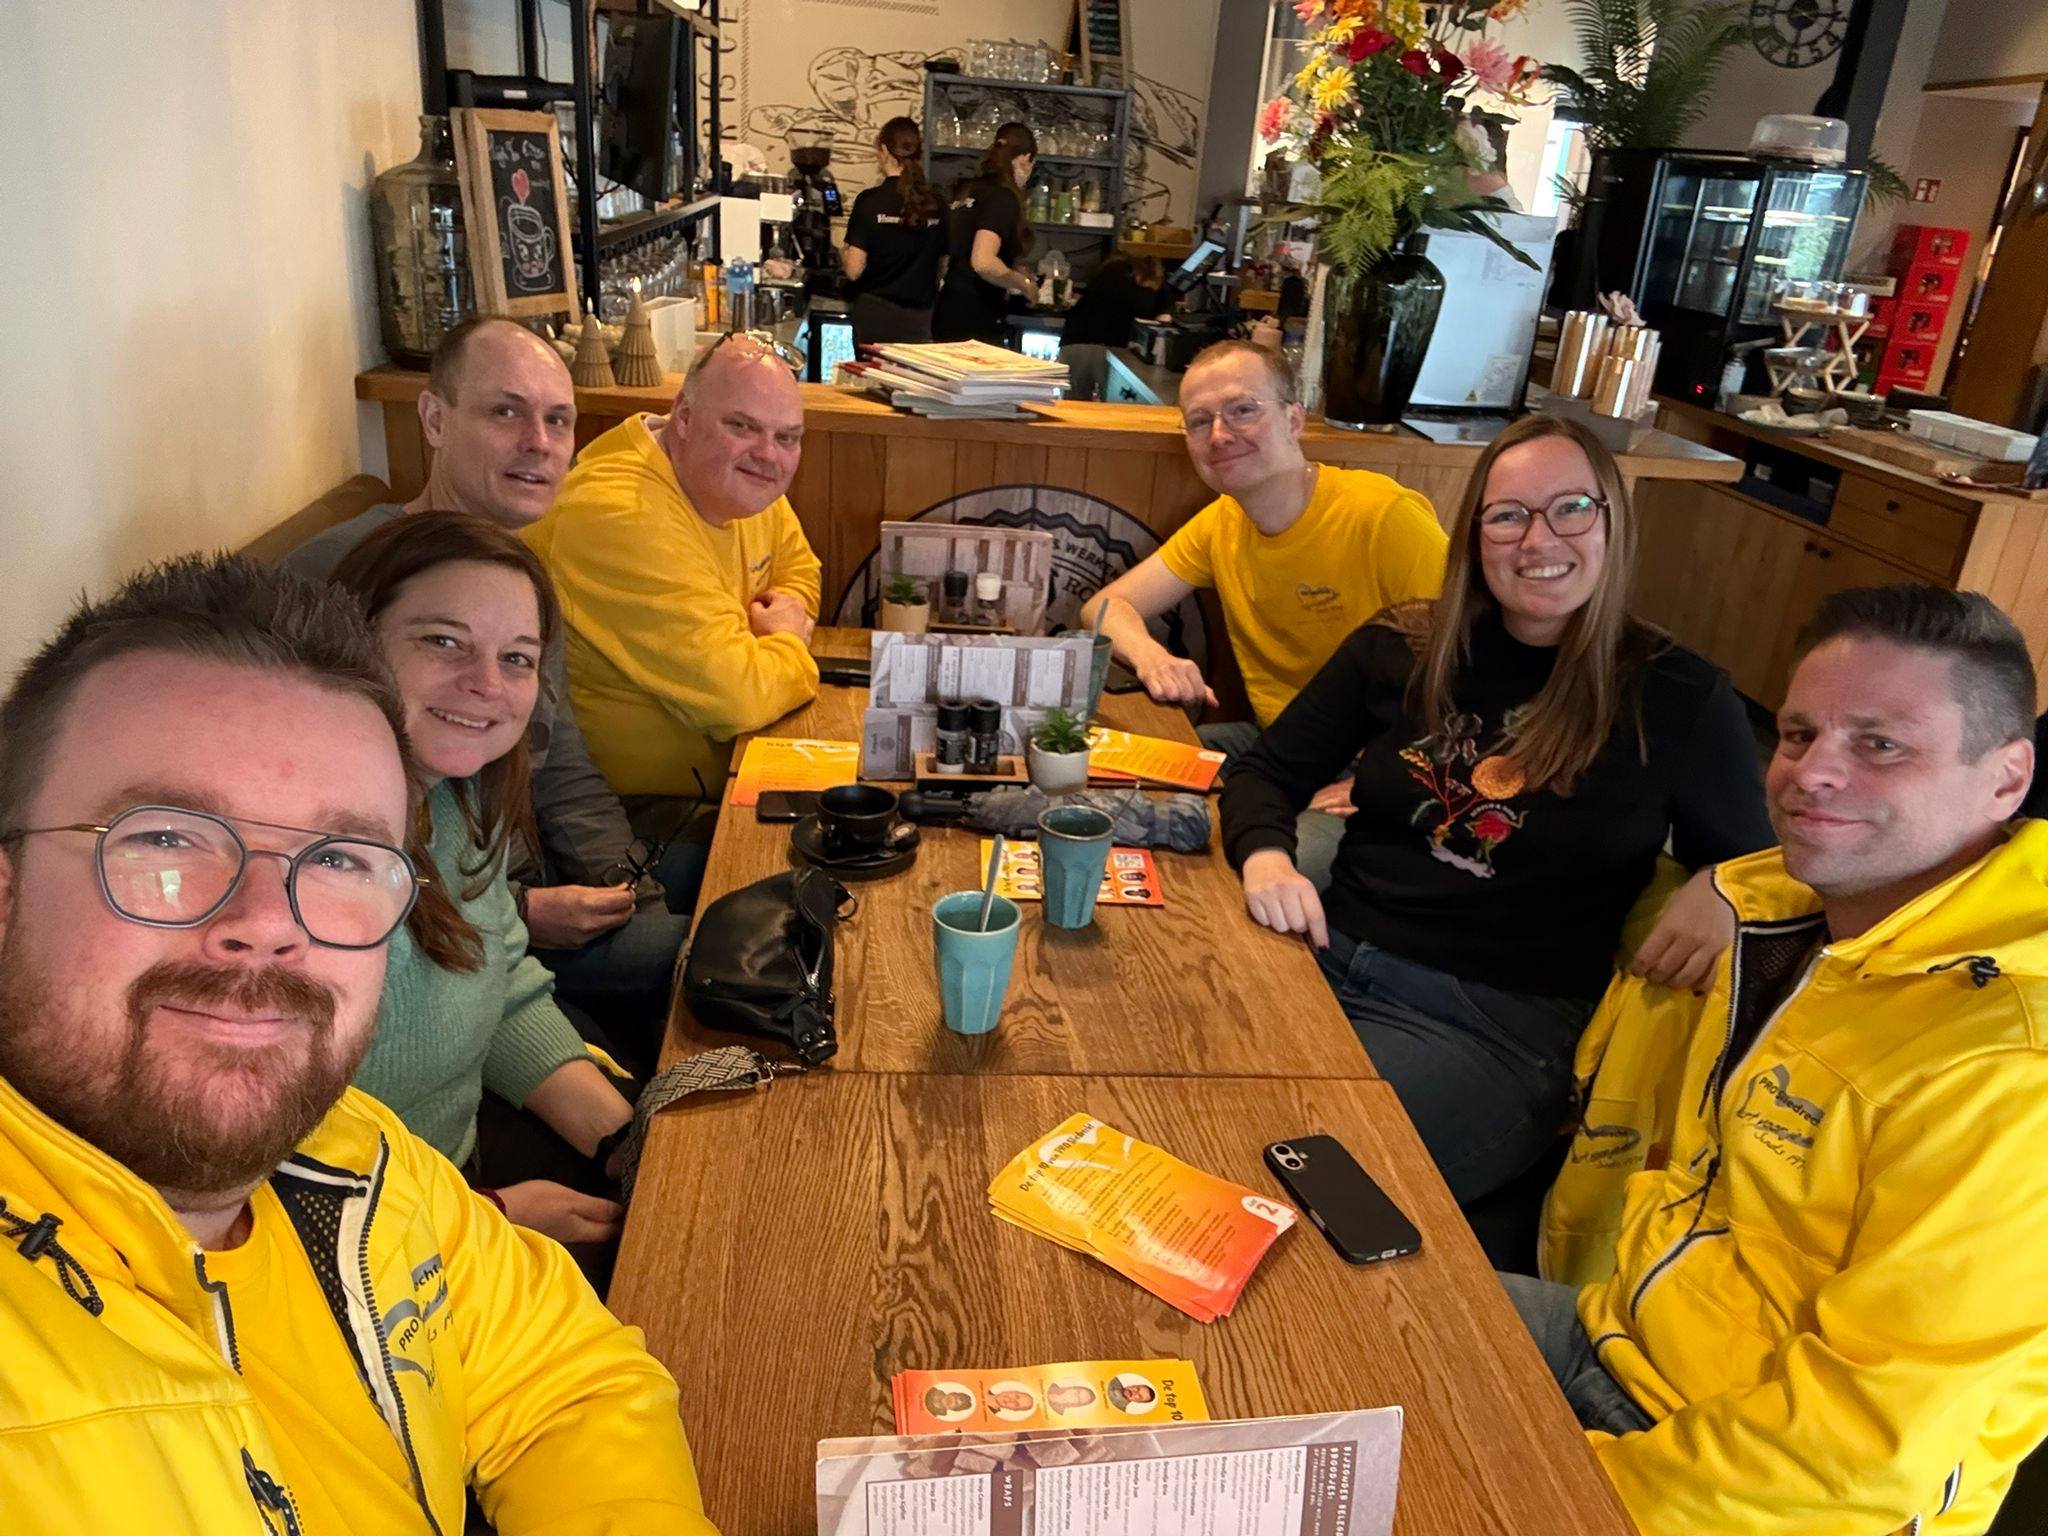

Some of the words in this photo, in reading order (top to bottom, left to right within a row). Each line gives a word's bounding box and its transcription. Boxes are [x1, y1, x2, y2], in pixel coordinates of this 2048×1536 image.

[1758, 1076, 1778, 1095] PRO
[1256, 1201, 1279, 1217] 2
[398, 1318, 420, 1352] PRO
[1162, 1380, 1174, 1391] De
[1164, 1393, 1177, 1408] top
[1171, 1411, 1183, 1421] 10
[1327, 1447, 1339, 1499] BROODJES:
[1339, 1447, 1351, 1500] BIJZONDER
[1003, 1475, 1013, 1508] WRAPS
